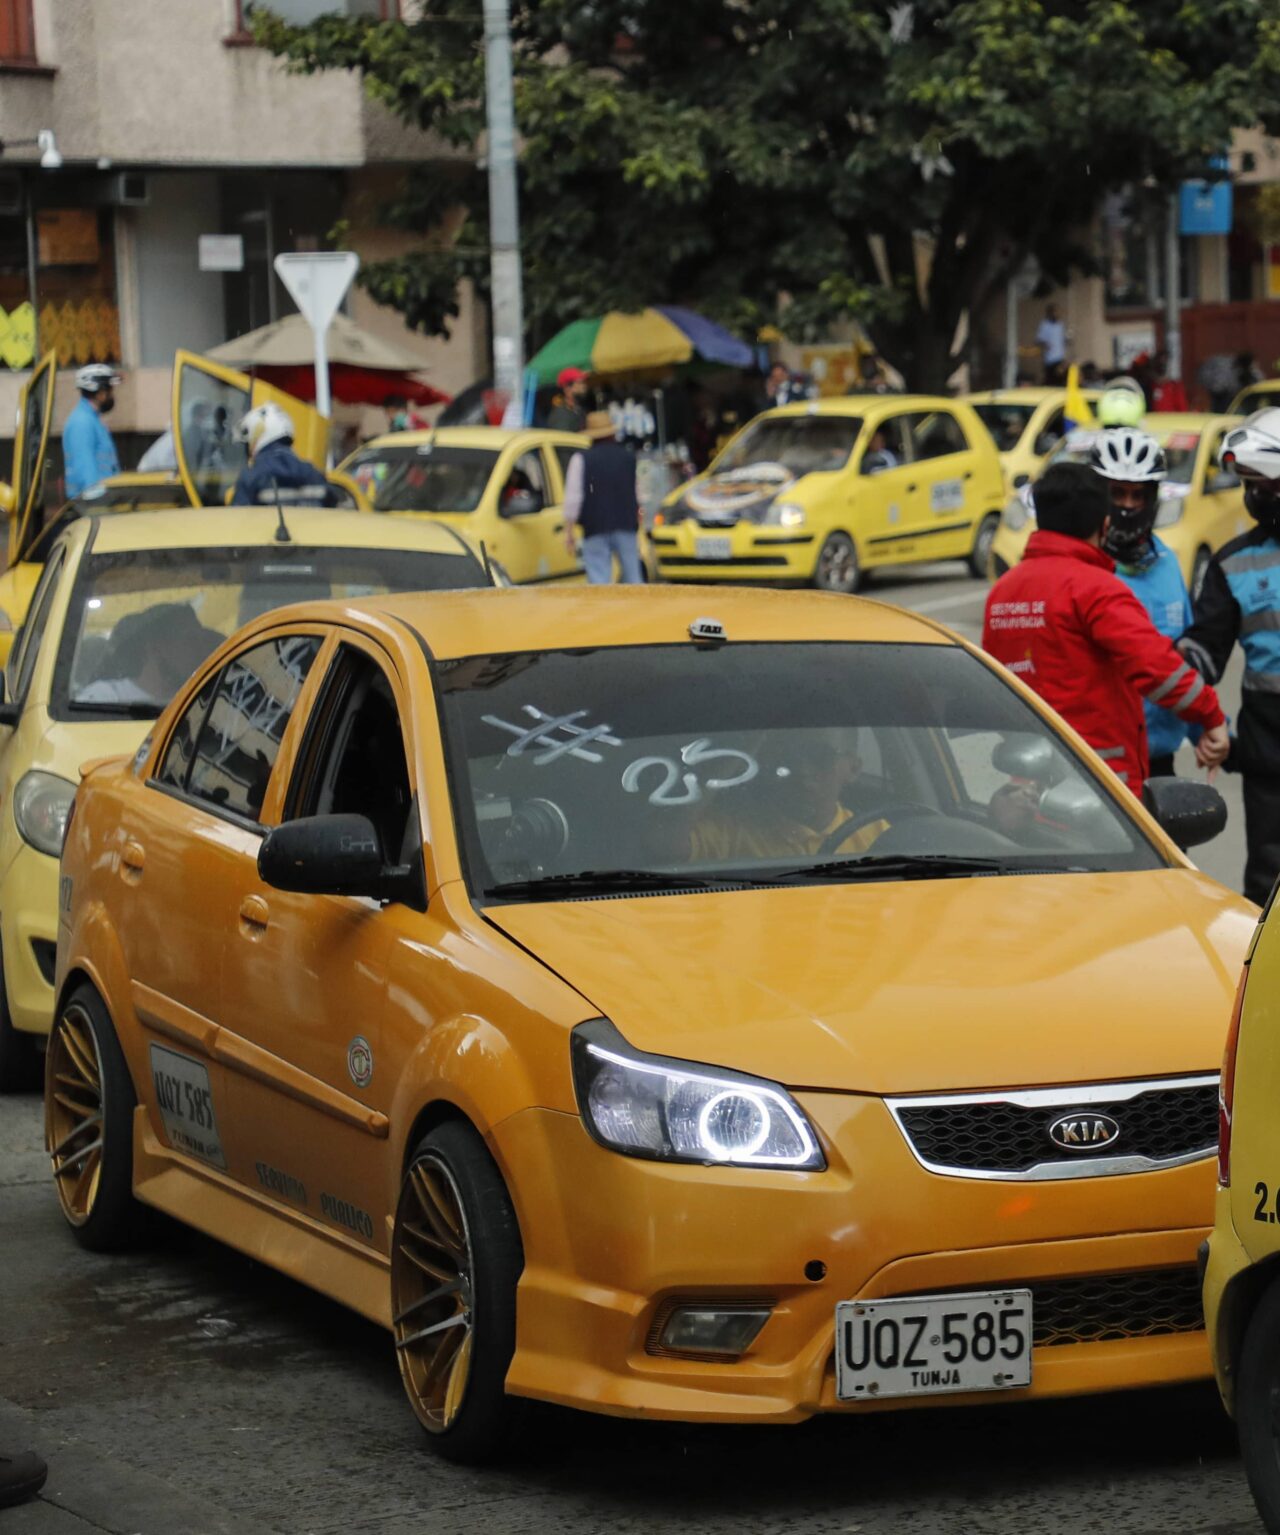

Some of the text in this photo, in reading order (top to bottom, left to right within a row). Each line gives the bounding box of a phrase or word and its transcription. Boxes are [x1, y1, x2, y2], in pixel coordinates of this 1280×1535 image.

[185, 1081, 213, 1131] 585
[1060, 1121, 1110, 1142] KIA
[845, 1309, 1025, 1371] UQZ 585
[911, 1369, 960, 1388] TUNJA
